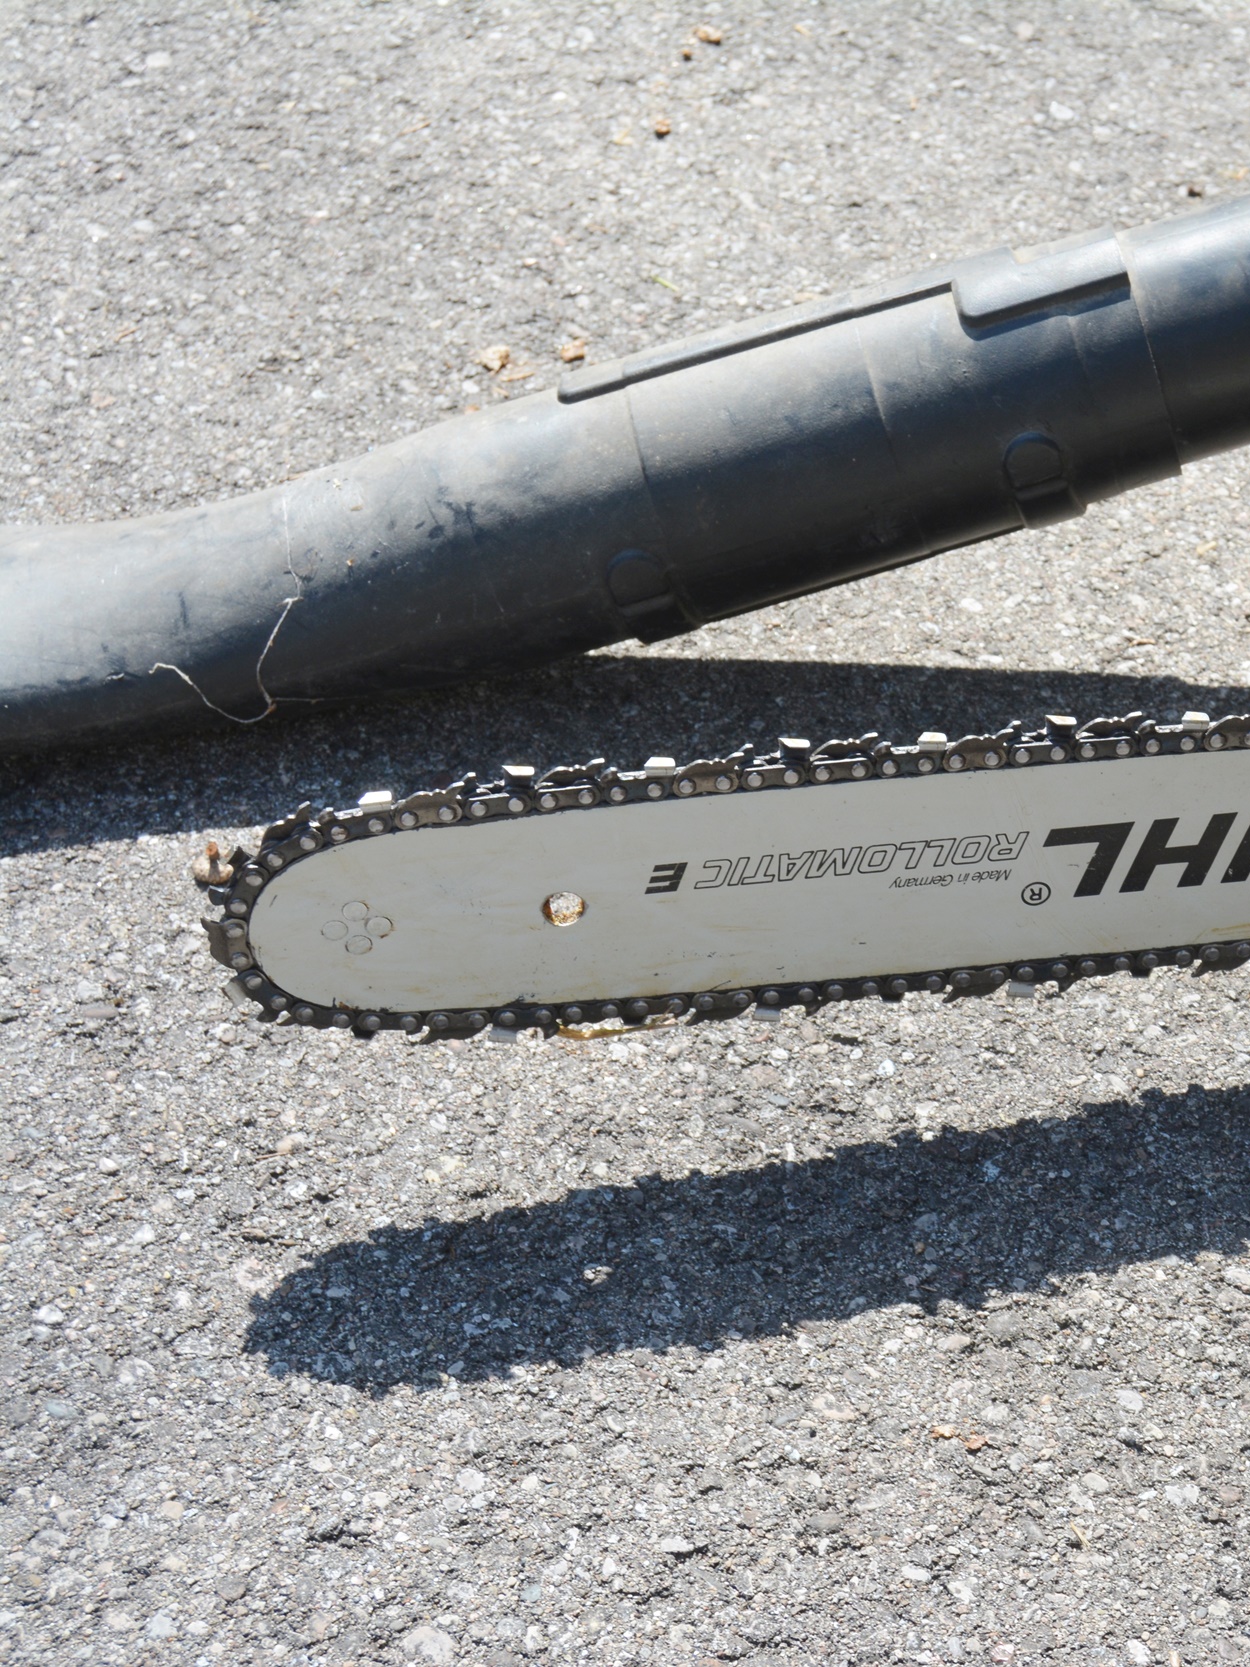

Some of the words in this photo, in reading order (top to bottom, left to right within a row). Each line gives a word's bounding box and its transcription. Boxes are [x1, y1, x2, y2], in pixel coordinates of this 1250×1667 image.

[693, 831, 1030, 890] ROLLOMATIC
[644, 861, 689, 895] E
[888, 873, 954, 889] Germany
[957, 872, 970, 885] in
[972, 868, 1012, 882] Made
